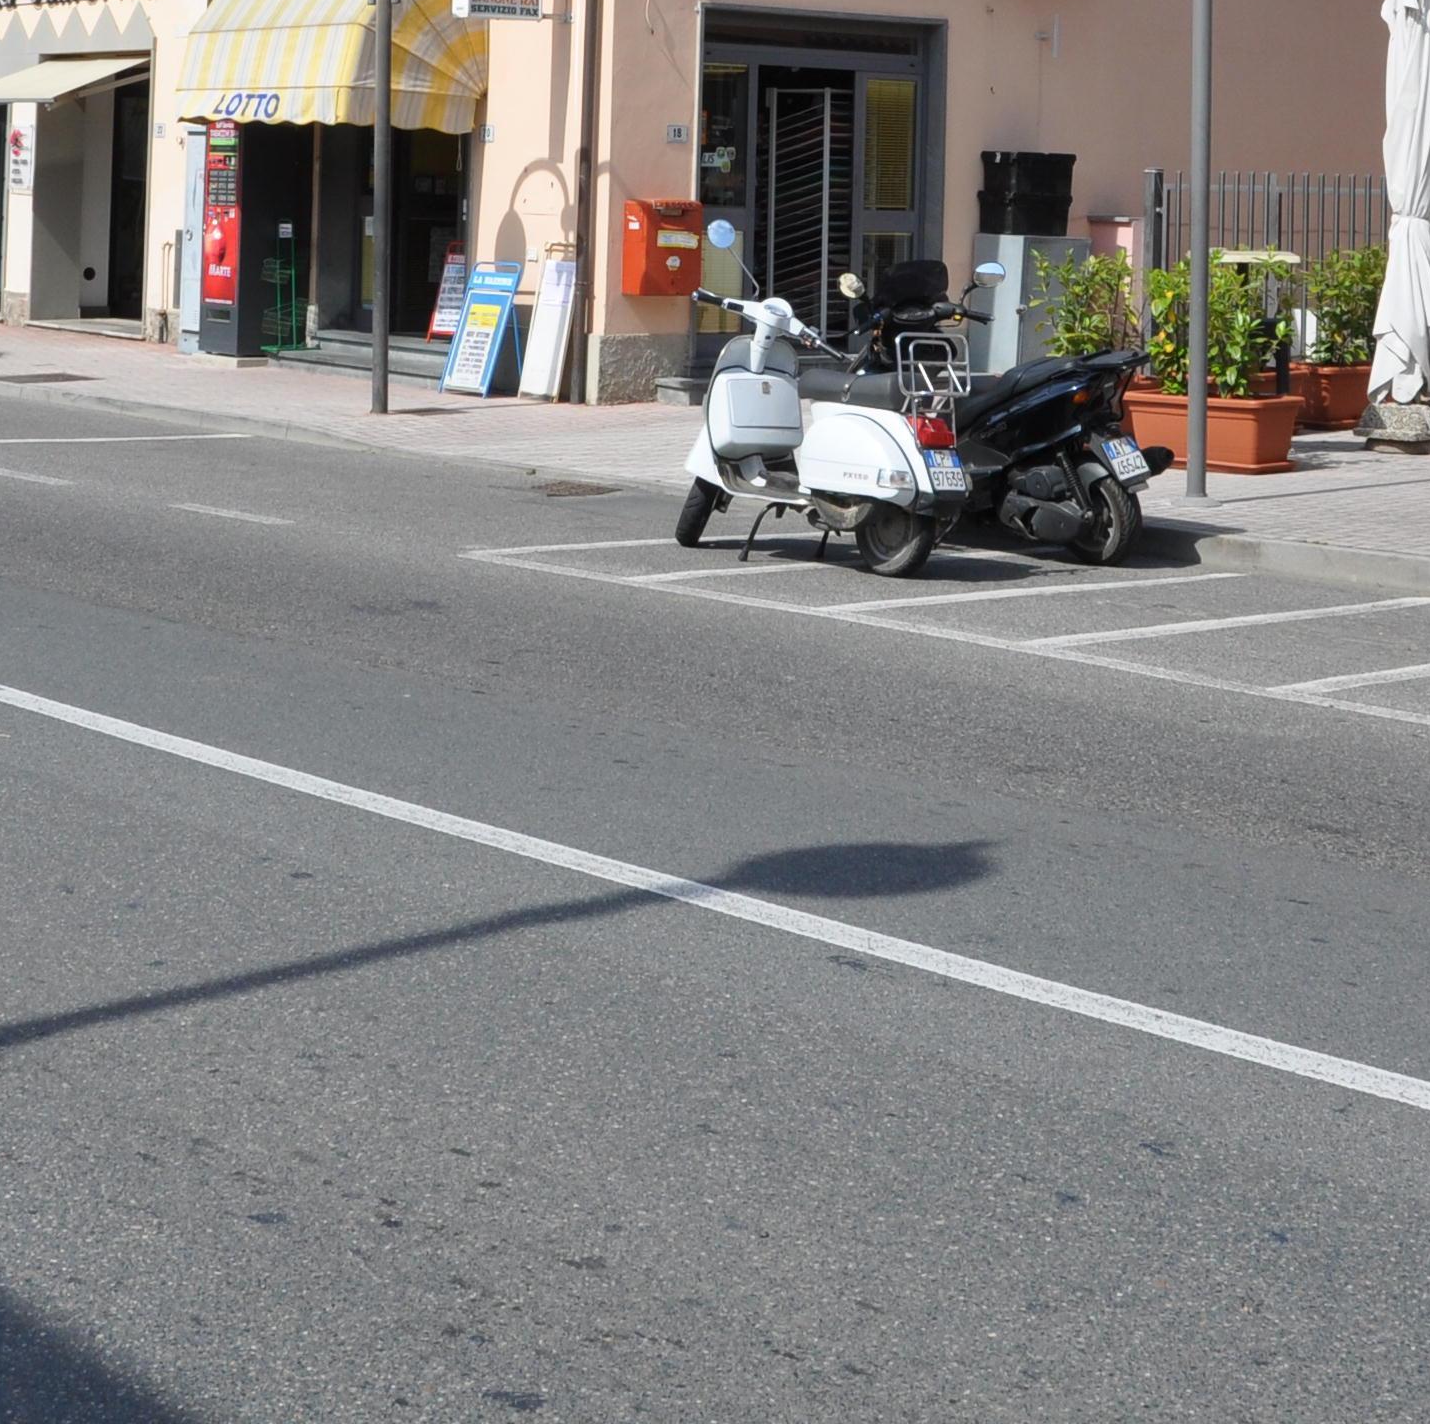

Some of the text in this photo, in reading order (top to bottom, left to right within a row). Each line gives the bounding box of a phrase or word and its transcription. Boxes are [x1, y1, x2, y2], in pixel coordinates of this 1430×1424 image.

[470, 4, 539, 17] SERVIZIO FAX
[212, 93, 280, 119] LOTTO
[673, 128, 682, 138] 18
[933, 470, 965, 488] 97639
